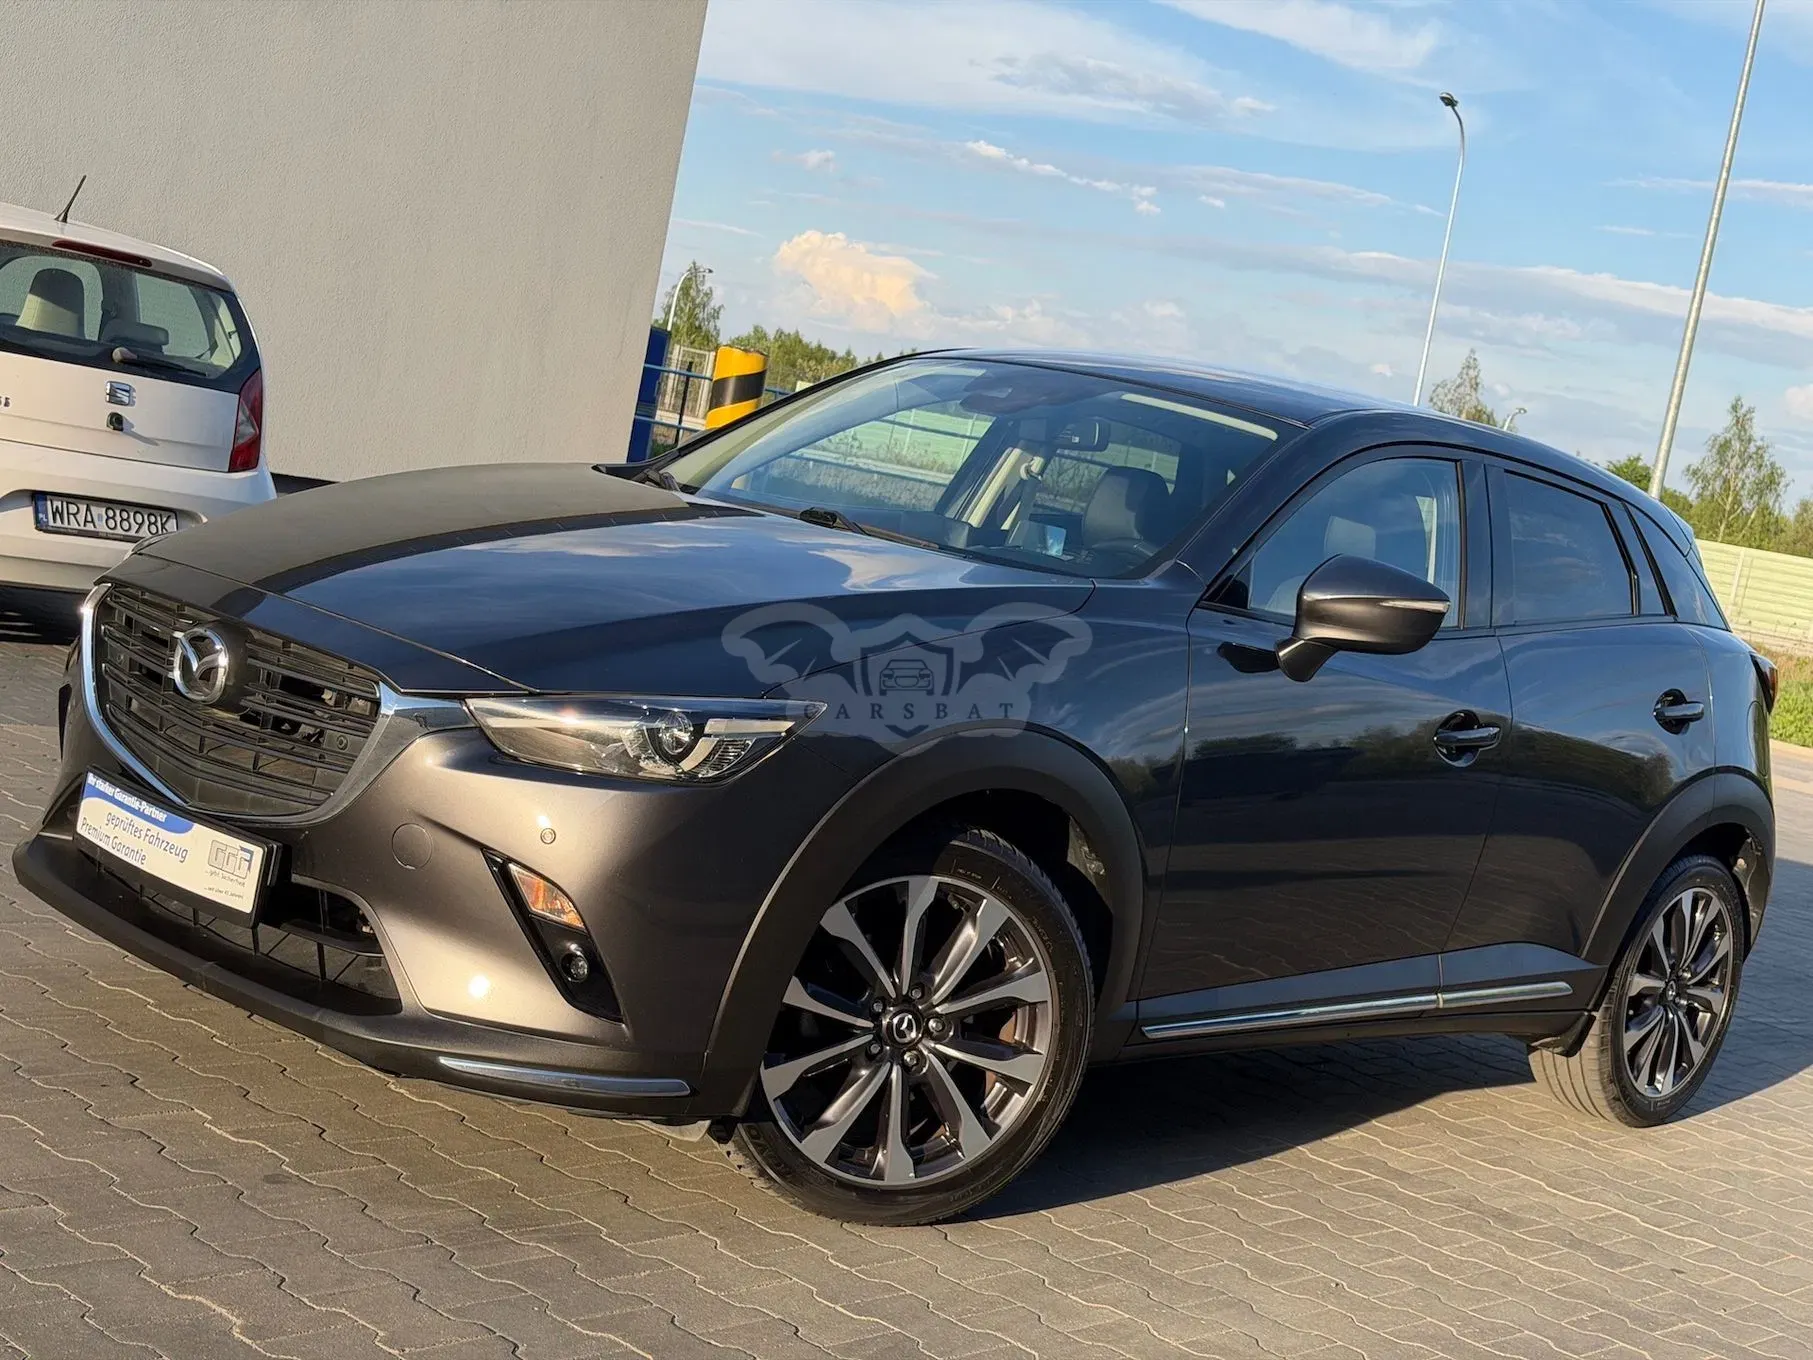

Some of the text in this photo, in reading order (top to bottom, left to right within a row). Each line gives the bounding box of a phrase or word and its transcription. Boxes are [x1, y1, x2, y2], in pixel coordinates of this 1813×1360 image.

[49, 498, 172, 536] WRA 8898K
[114, 787, 168, 823] Garantie-Partner
[80, 817, 147, 865] Premium Garantie
[106, 812, 189, 863] geprüftes Fahrzeug
